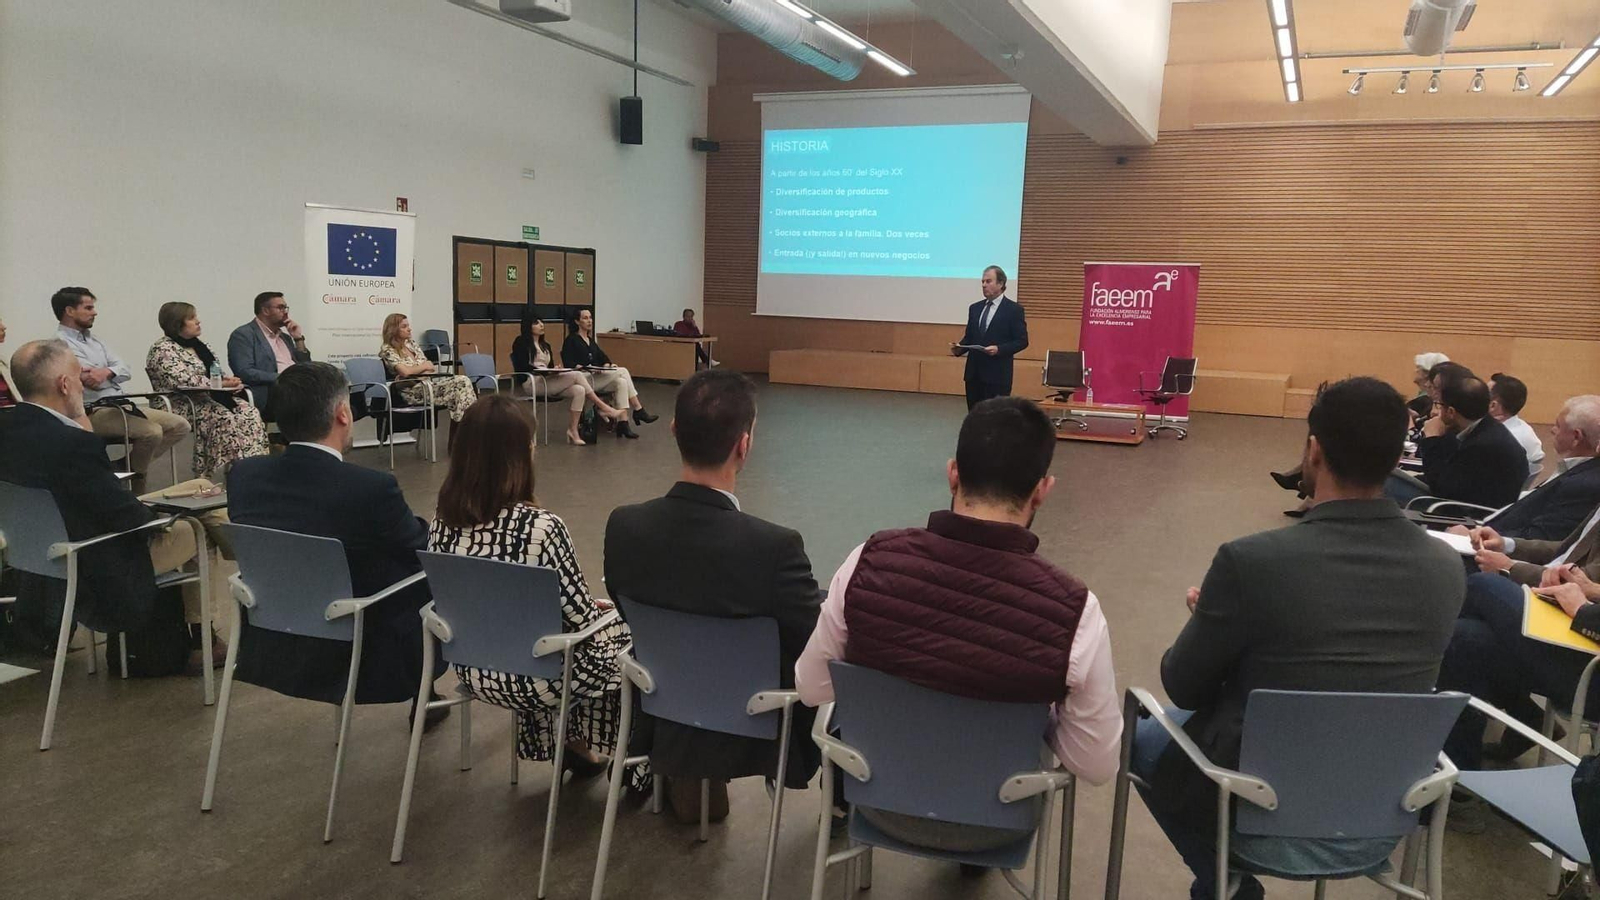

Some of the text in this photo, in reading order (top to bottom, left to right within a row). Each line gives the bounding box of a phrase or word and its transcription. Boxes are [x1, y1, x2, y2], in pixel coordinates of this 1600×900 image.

[771, 140, 829, 152] HISTORIA
[798, 169, 808, 177] de
[809, 168, 820, 177] los
[855, 168, 868, 177] del
[869, 167, 889, 178] Siglo
[890, 167, 904, 176] XX
[775, 187, 889, 198] Diversificación de productos
[775, 207, 878, 218] Diversificación geográfica
[774, 228, 801, 237] Socios
[802, 229, 837, 238] externos
[838, 230, 844, 238] a
[845, 229, 853, 238] la
[886, 229, 903, 238] Dos
[904, 230, 930, 239] veces
[774, 248, 804, 258] Entrada
[848, 250, 859, 258] en
[860, 250, 890, 259] nuevos
[891, 250, 931, 261] negocios
[328, 278, 396, 289] UNIÓN EUROPEA
[1090, 282, 1153, 308] faeem
